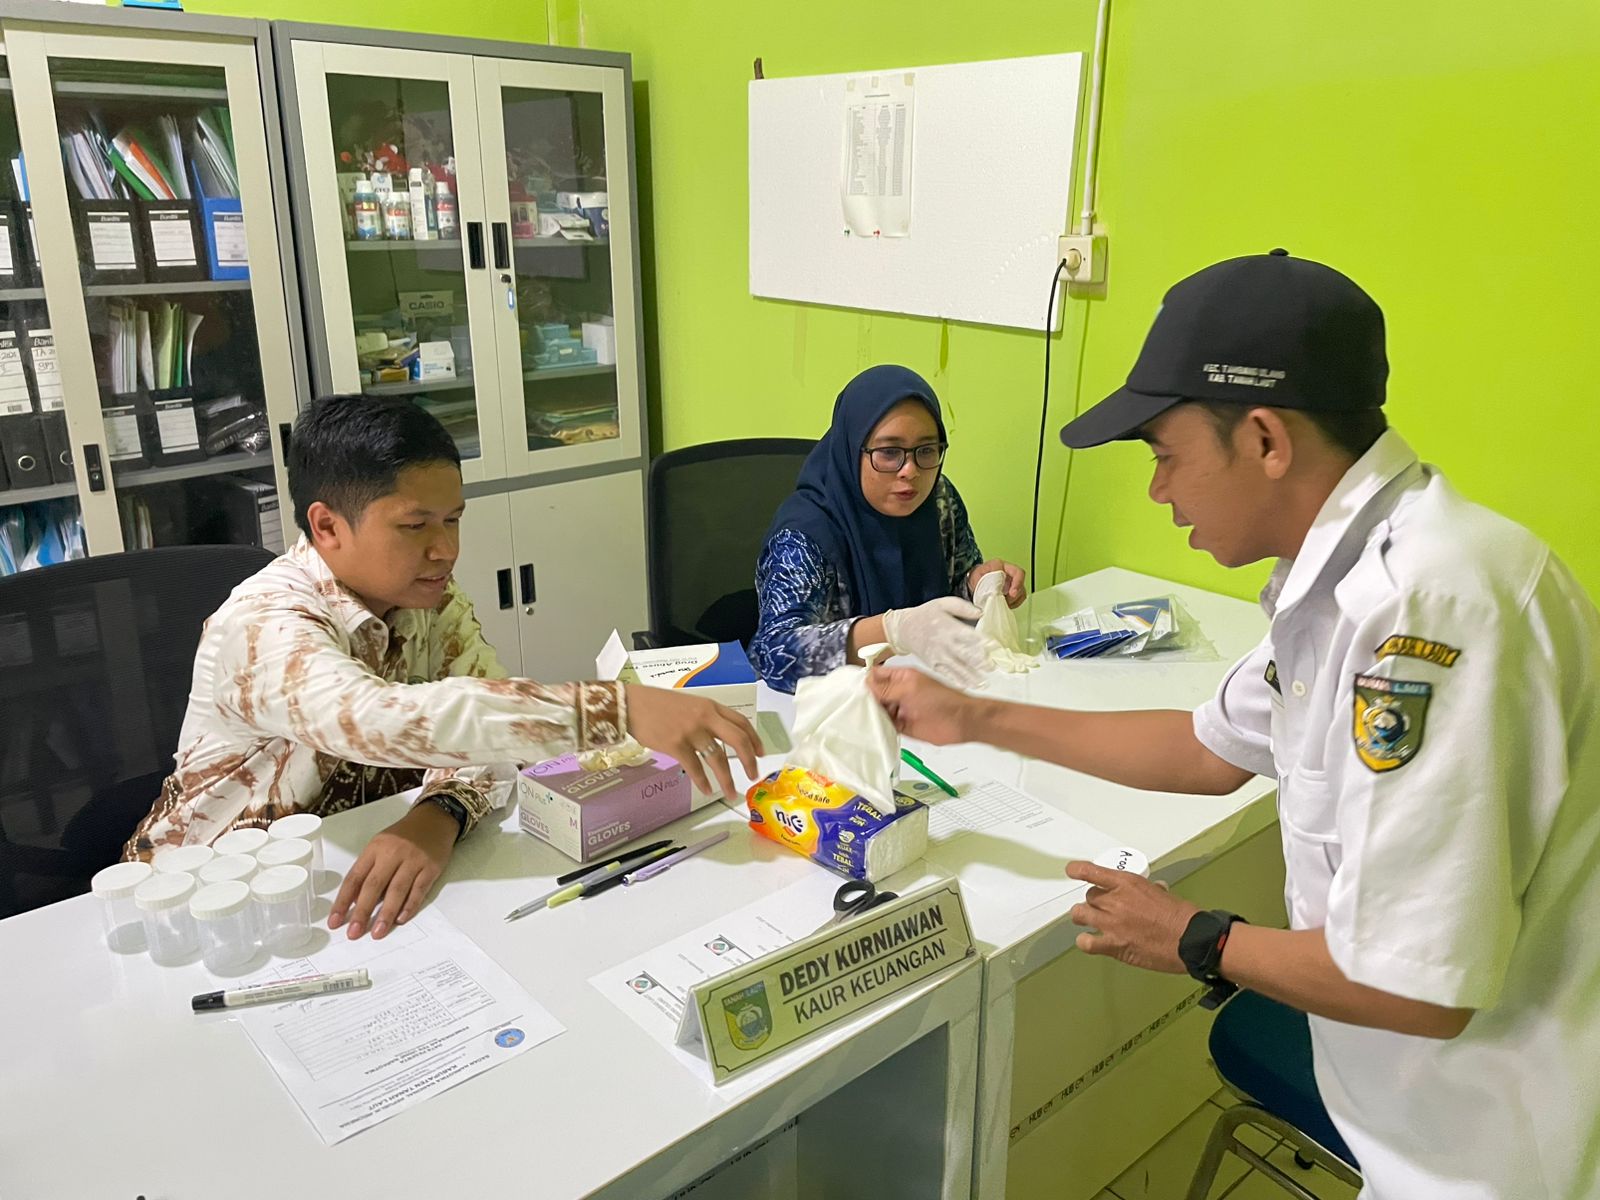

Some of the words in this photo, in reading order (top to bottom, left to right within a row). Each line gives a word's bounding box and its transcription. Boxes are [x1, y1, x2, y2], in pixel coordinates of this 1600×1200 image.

[409, 301, 445, 310] CASIO
[567, 766, 621, 794] GLOVES
[641, 783, 664, 799] ION
[814, 794, 831, 805] Safe
[856, 801, 882, 821] TEBAL
[520, 811, 551, 834] GLOVES
[570, 817, 578, 829] M
[587, 821, 632, 846] GLOVES
[779, 953, 830, 997] DEDY
[834, 904, 945, 971] KURNIAWAN
[794, 984, 848, 1024] KAUR
[850, 937, 947, 998] KEUANGAN
